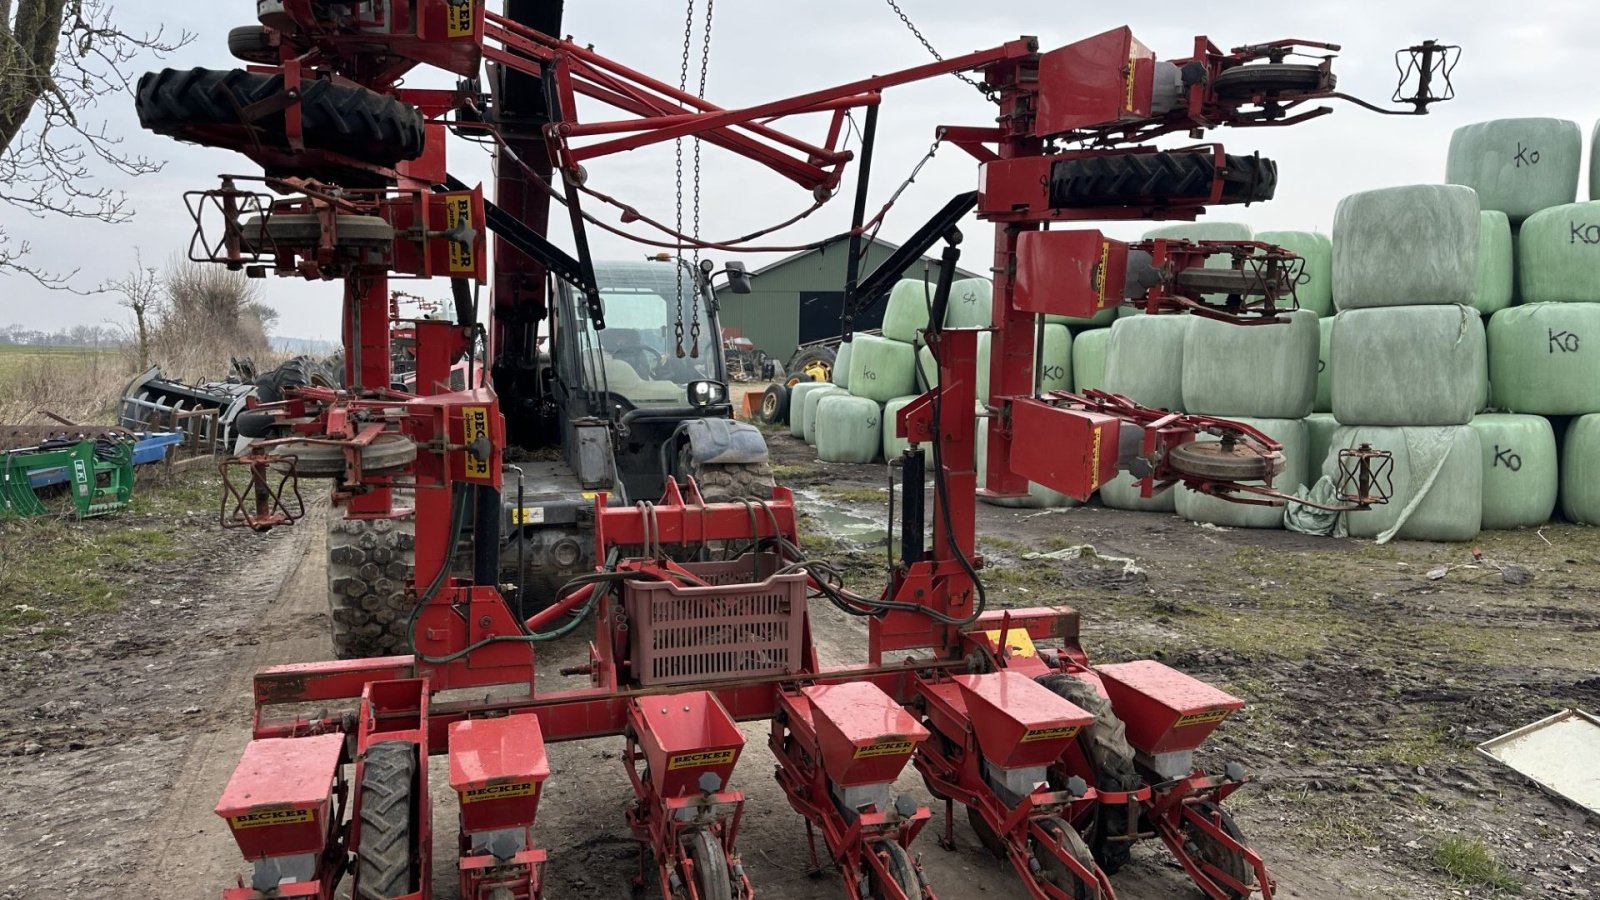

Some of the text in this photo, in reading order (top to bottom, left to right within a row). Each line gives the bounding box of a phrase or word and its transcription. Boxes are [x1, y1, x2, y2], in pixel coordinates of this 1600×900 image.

[474, 411, 487, 474] BECR
[1181, 710, 1227, 721] BECKER
[1027, 726, 1079, 736] BECKER
[859, 742, 912, 753] BECKER
[673, 751, 732, 763] BECKER
[466, 783, 532, 796] BECKER
[236, 809, 308, 822] BECKER
